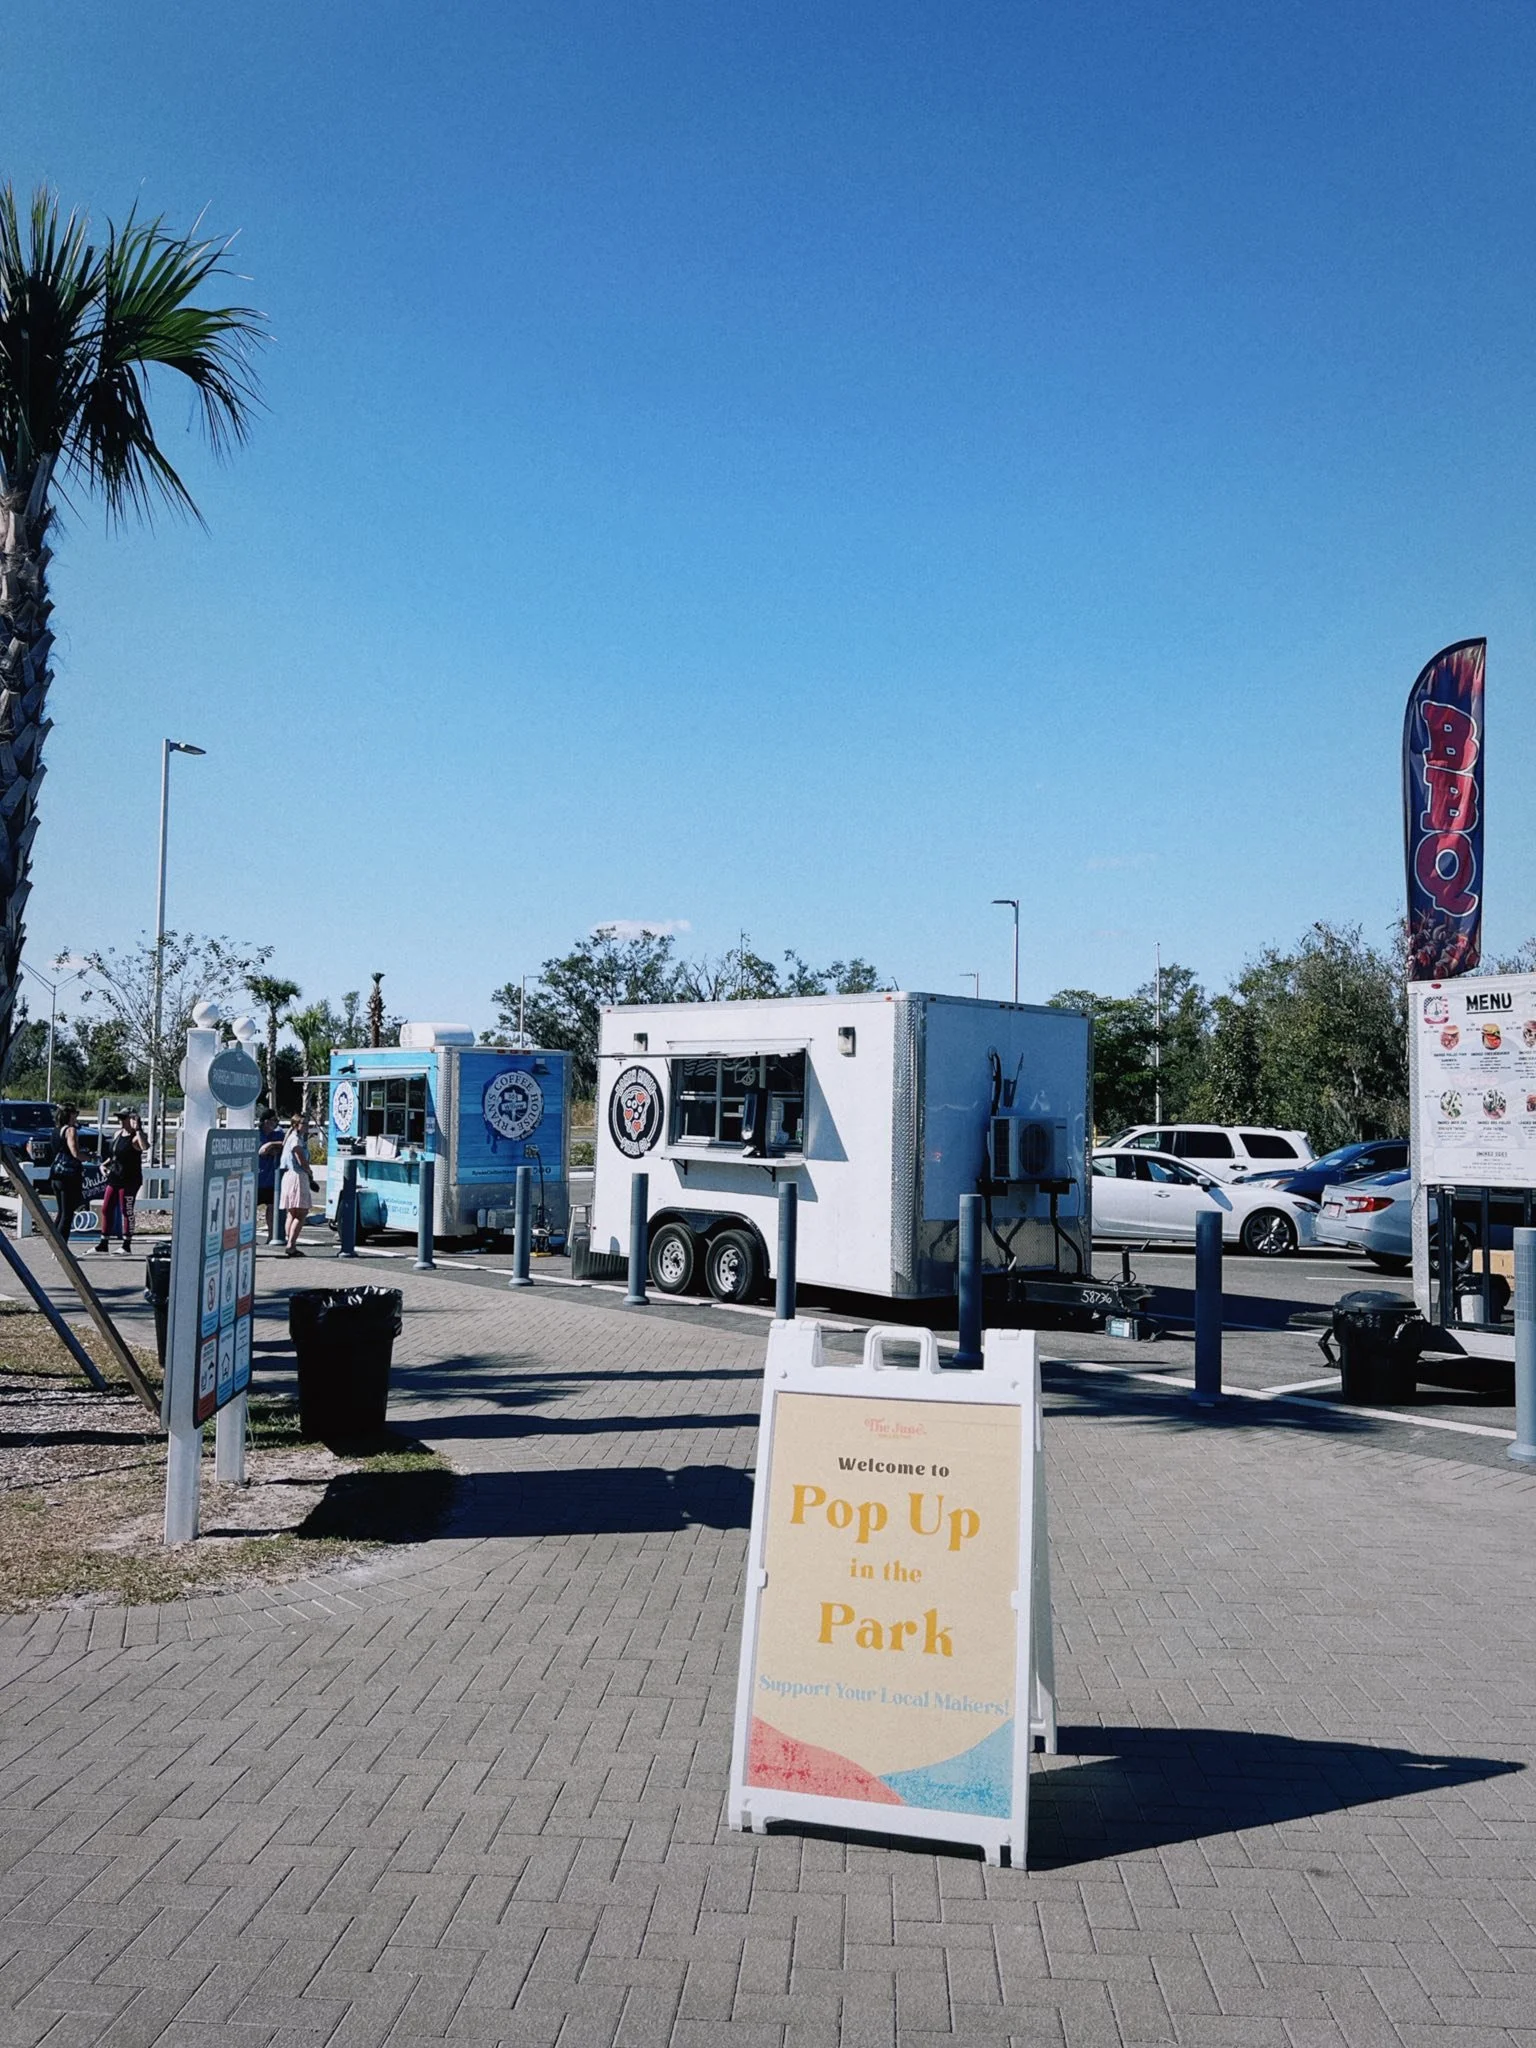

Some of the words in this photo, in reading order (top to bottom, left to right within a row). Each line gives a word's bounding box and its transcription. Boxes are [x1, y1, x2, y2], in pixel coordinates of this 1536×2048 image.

[1414, 700, 1480, 917] BBQ
[1465, 992, 1513, 1011] MENU
[494, 1074, 534, 1091] COFFEE
[517, 1093, 539, 1131] HOUSE
[211, 1138, 232, 1155] GENERAL
[232, 1138, 244, 1154] PARK
[244, 1137, 256, 1153] RULES
[124, 1195, 134, 1216] pure
[1080, 1290, 1112, 1304] 58736
[838, 1457, 926, 1476] Welcome
[931, 1462, 950, 1478] to
[789, 1483, 889, 1544] Pop
[908, 1492, 981, 1551] Up
[849, 1558, 874, 1579] in
[883, 1560, 922, 1583] the
[817, 1601, 953, 1657] Park
[758, 1674, 831, 1698] Support
[834, 1683, 876, 1702] Your
[881, 1687, 930, 1707] Local
[934, 1692, 1010, 1717] Makers!
